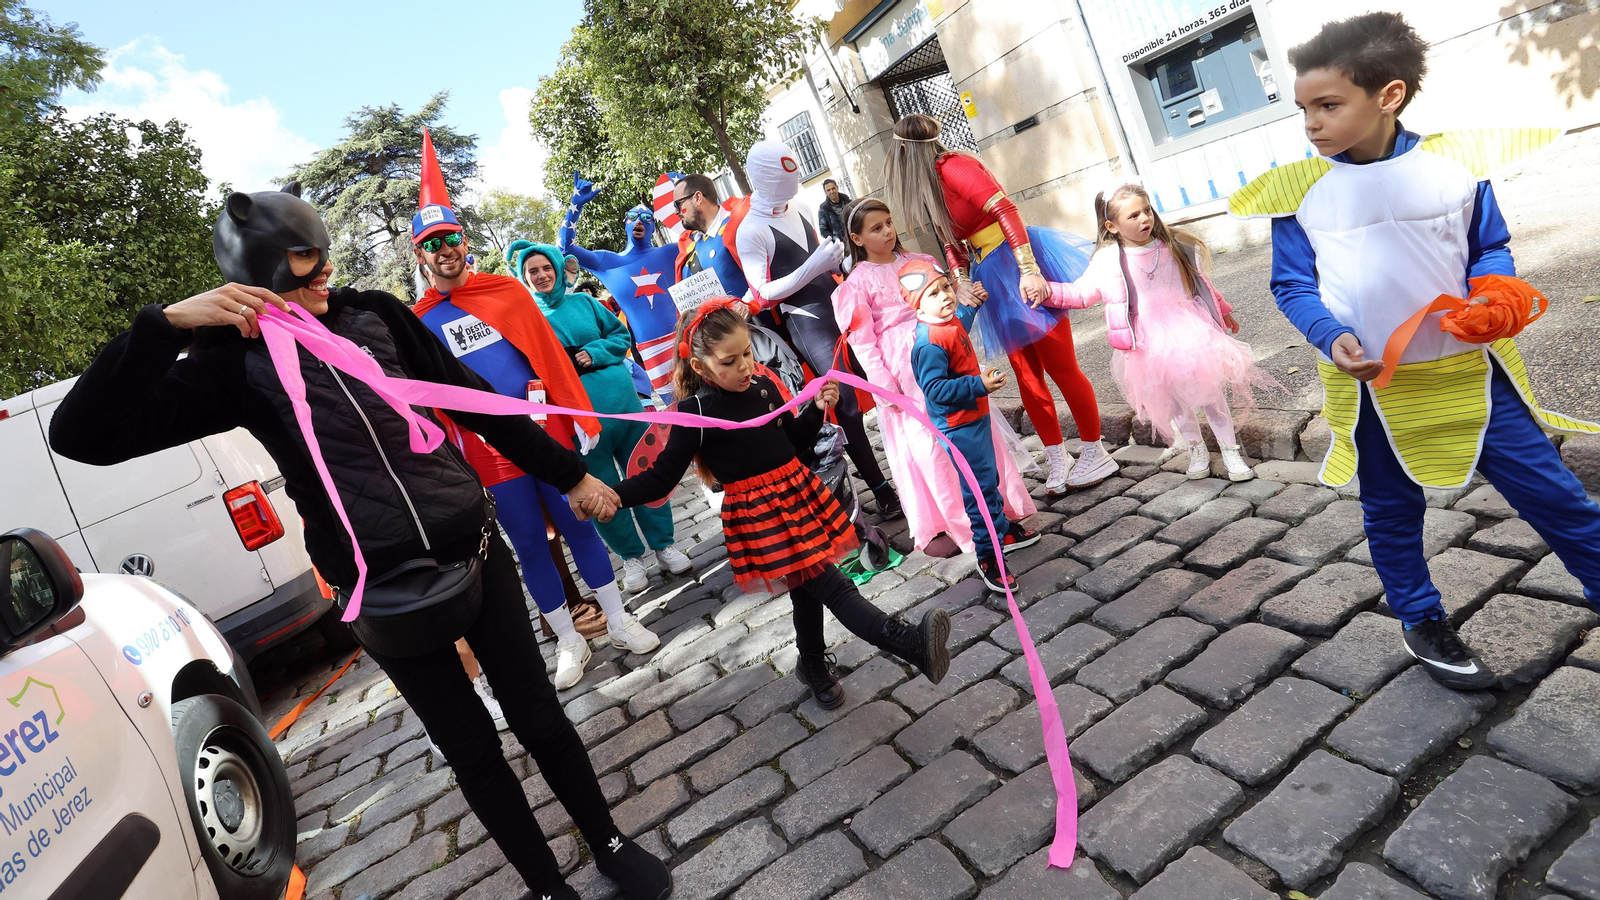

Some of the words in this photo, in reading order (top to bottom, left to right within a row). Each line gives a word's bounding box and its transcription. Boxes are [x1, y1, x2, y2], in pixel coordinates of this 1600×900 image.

[1122, 38, 1165, 63] Disponible
[1165, 30, 1178, 41] 24
[1178, 16, 1207, 35] horas,
[1208, 5, 1227, 20] 365
[672, 286, 684, 295] SE
[684, 272, 710, 288] VENDE
[465, 321, 490, 336] DESTR
[136, 628, 159, 656] 900
[158, 615, 181, 641] 810
[0, 756, 78, 837] Municipal
[27, 829, 51, 858] de
[51, 786, 93, 835] Jerez
